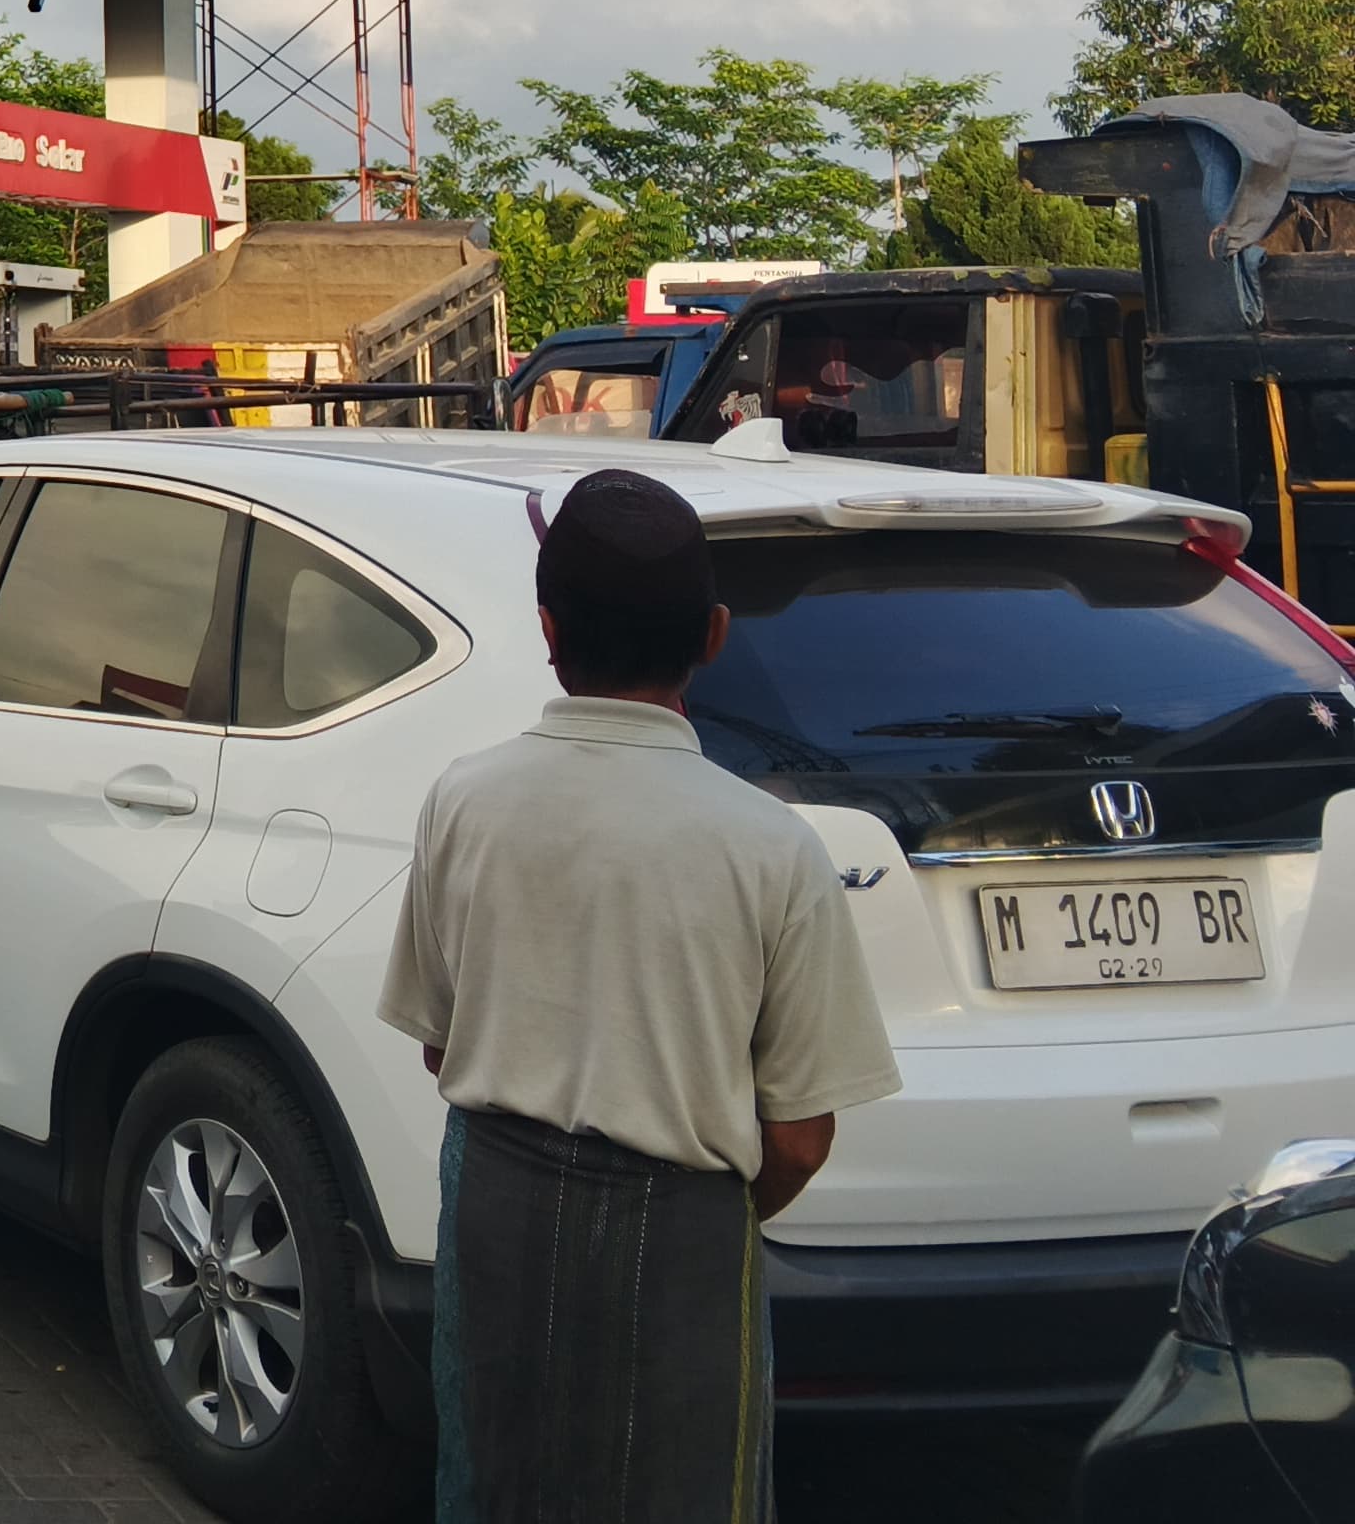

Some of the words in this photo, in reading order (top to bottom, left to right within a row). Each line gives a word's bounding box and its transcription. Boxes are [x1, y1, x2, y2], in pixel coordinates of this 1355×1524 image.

[35, 134, 85, 173] Solar
[994, 896, 1025, 951] M
[1058, 891, 1161, 948] 1409
[1193, 889, 1249, 944] BR
